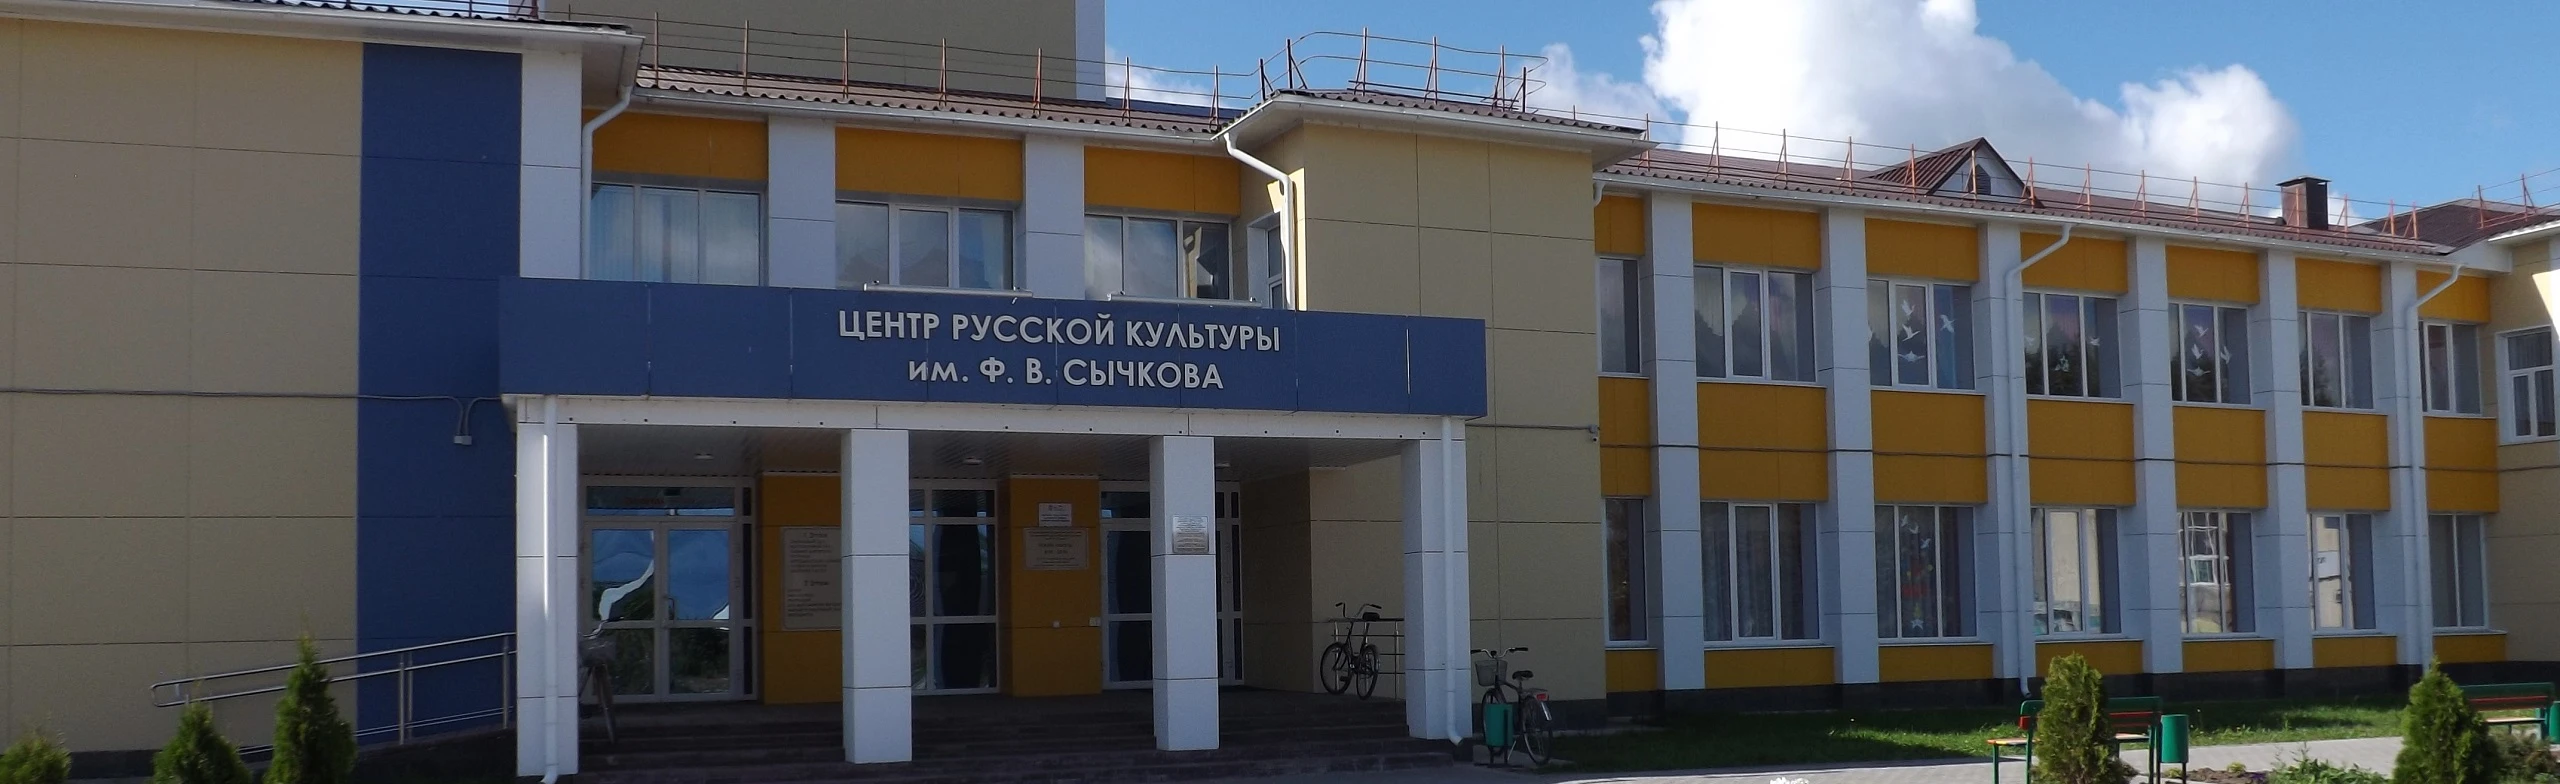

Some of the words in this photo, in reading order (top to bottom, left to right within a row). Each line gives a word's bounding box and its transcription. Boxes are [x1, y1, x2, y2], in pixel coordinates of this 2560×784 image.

[838, 310, 940, 341] ЦЕНТР
[952, 312, 1114, 344] РУССКОЙ
[1126, 320, 1281, 352] КУЛЬТУРЫ
[908, 360, 968, 382] им.
[979, 356, 1013, 383] Ф.
[1026, 357, 1052, 384] В.
[1063, 358, 1224, 389] СЫЧКОВА
